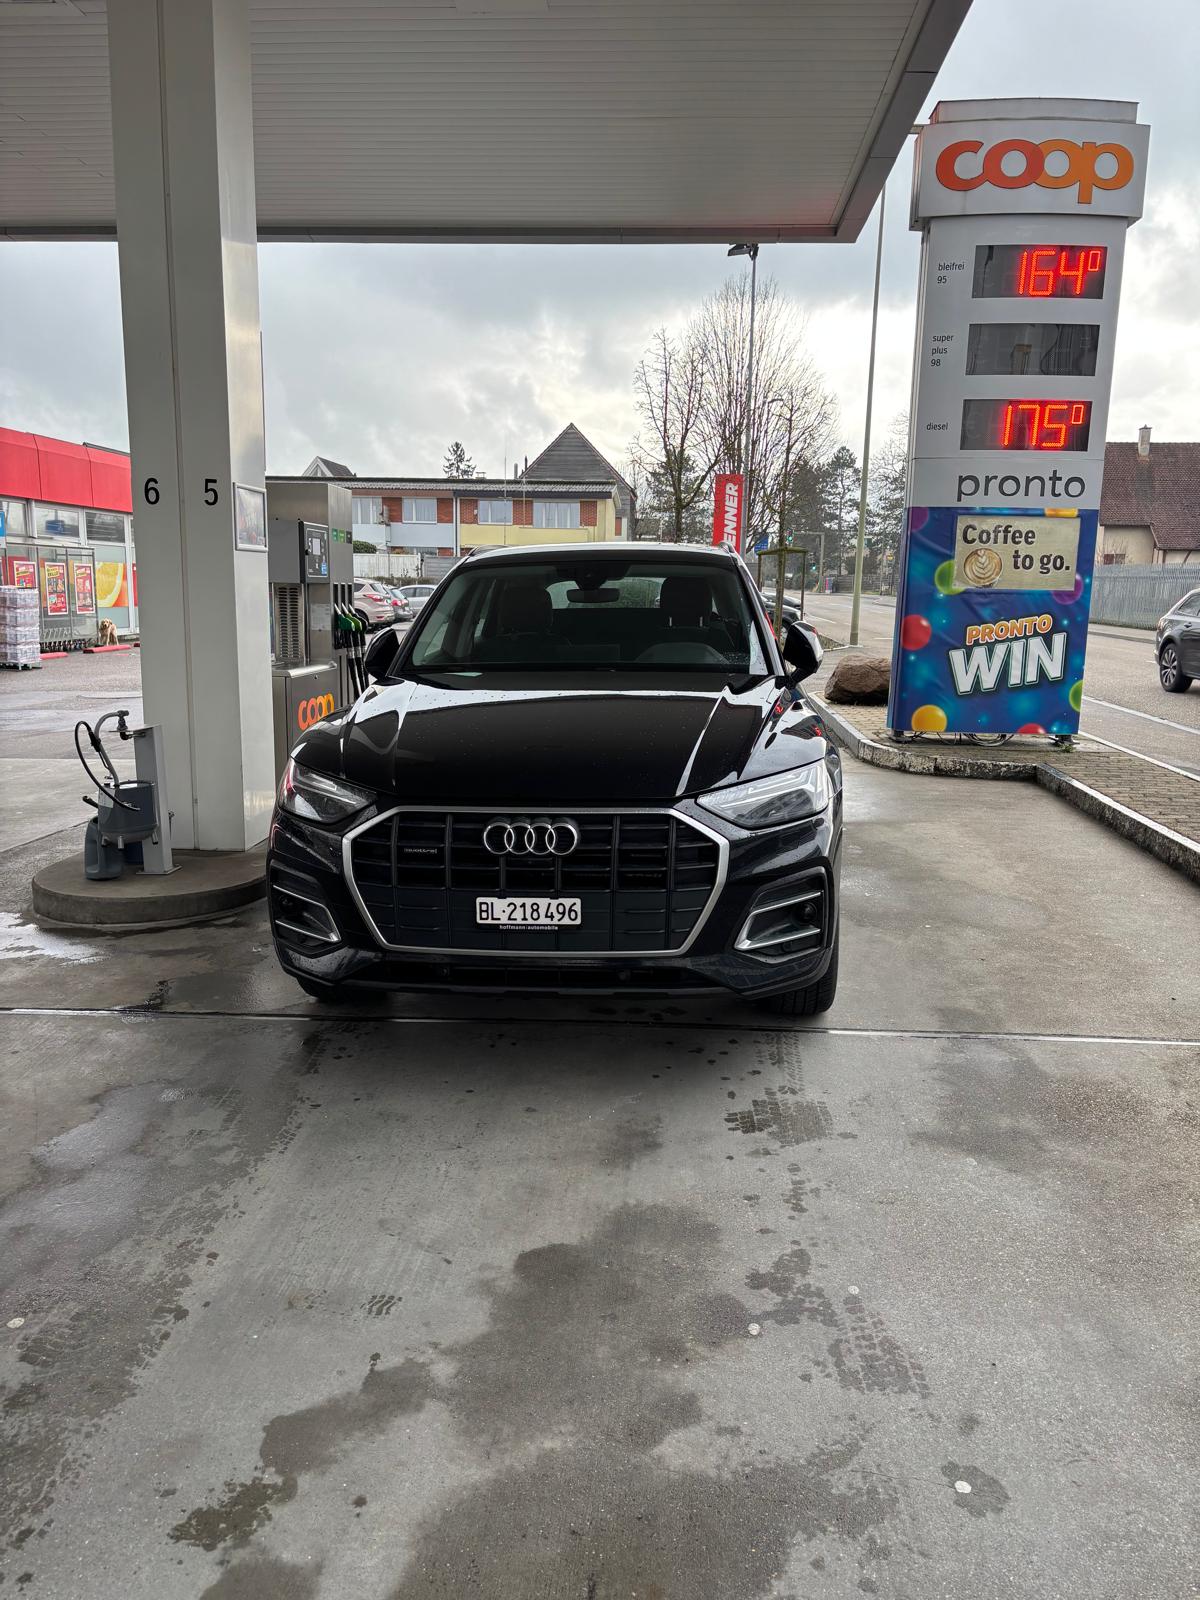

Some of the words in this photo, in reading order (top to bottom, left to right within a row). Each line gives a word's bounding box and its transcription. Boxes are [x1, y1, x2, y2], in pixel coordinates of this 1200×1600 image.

[935, 138, 1135, 205] coop
[938, 261, 965, 271] bleifrei
[937, 275, 948, 284] 95
[932, 334, 954, 344] super
[930, 358, 941, 367] 98
[931, 347, 948, 356] plus
[926, 422, 949, 431] diesel
[144, 477, 160, 505] 6
[204, 478, 218, 506] 5
[957, 469, 1086, 502] pronto
[962, 524, 1036, 545] Coffee
[1012, 549, 1034, 570] to
[1039, 553, 1070, 575] go.
[966, 614, 1053, 646] PRONTO
[948, 632, 1067, 695] WIN
